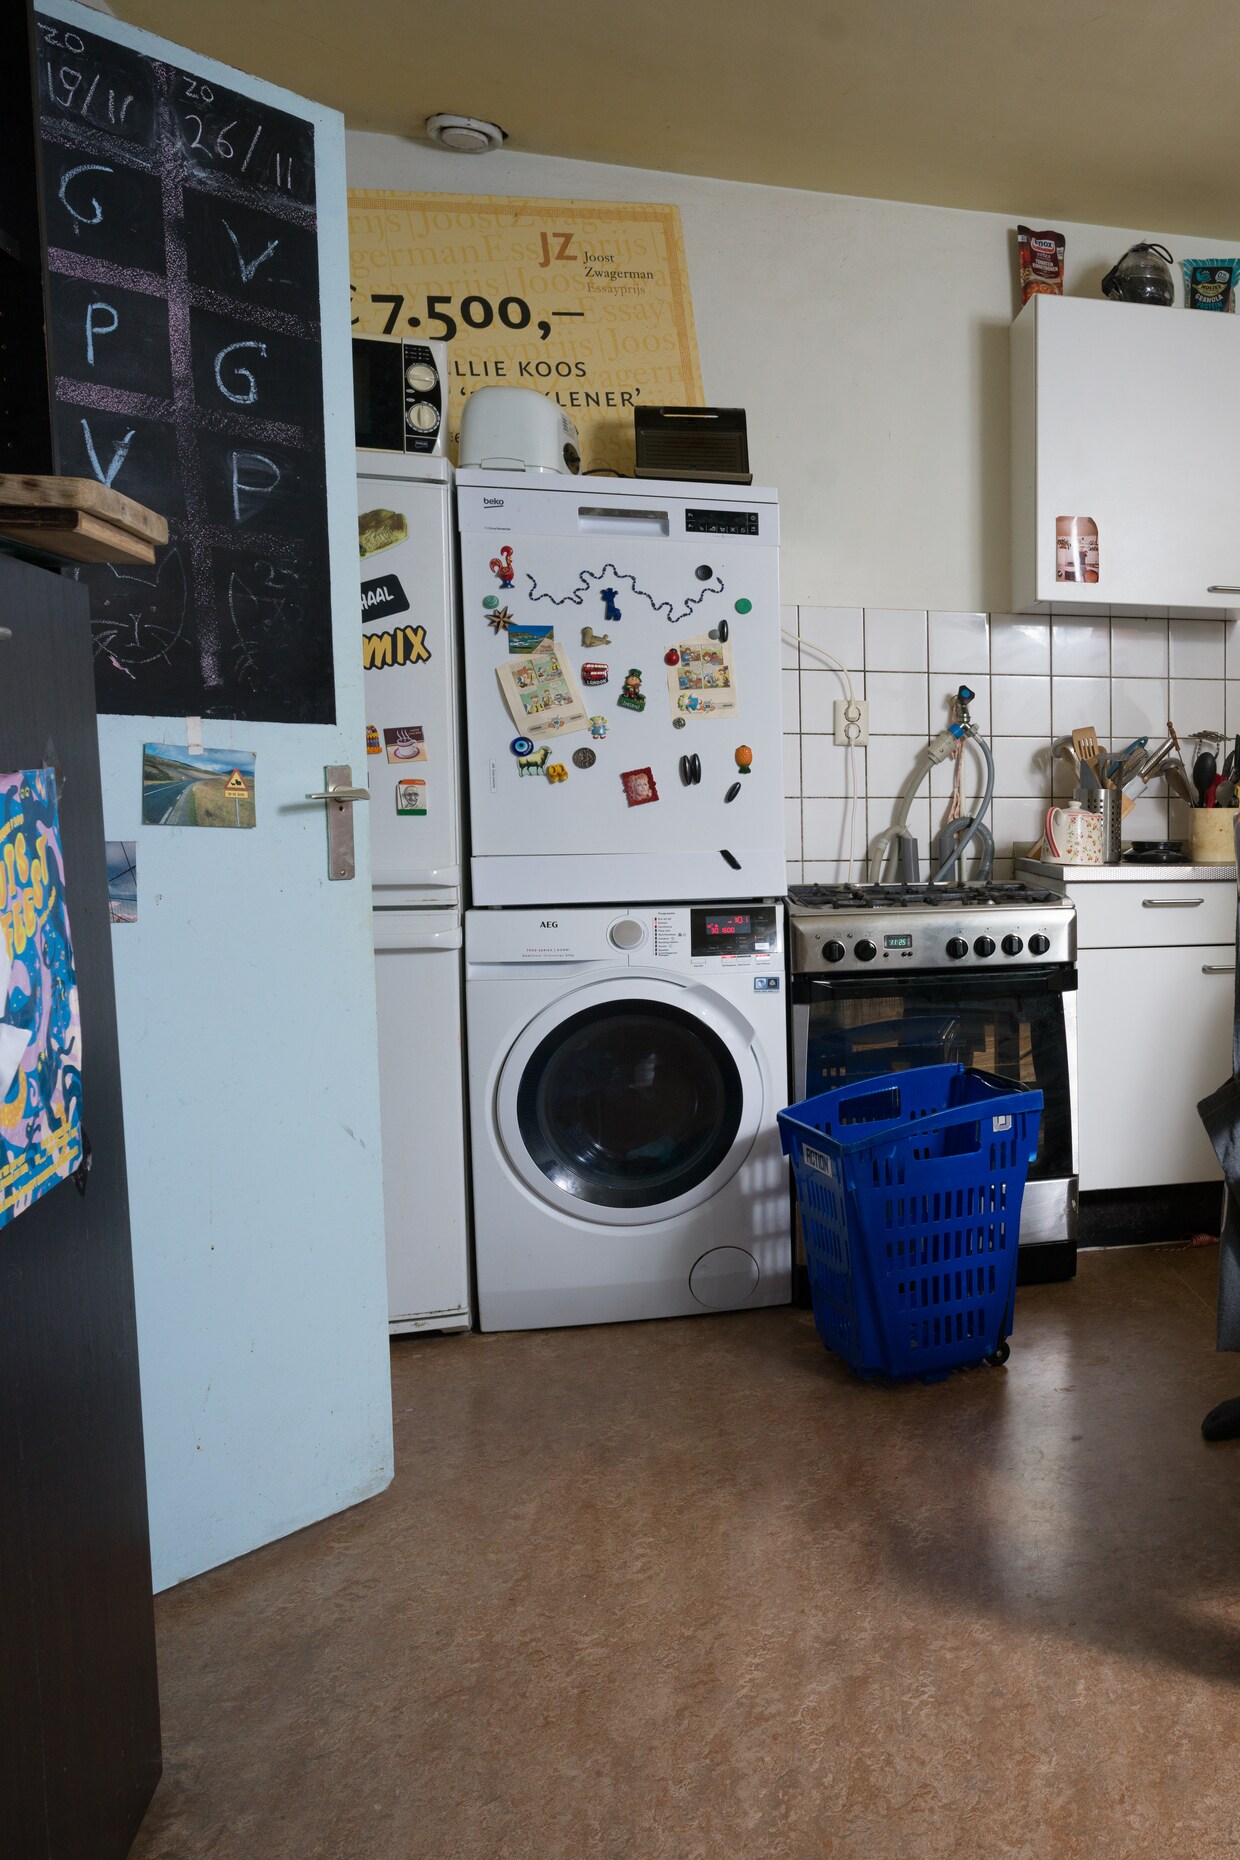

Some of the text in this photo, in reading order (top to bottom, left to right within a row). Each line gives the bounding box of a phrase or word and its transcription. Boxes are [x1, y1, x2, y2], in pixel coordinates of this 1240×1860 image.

[538, 232, 578, 268] JZ
[583, 251, 615, 264] Joost
[584, 266, 654, 280] Zwagerman
[587, 282, 646, 296] Essayprijs
[1195, 293, 1224, 303] GRANOLA
[448, 360, 587, 377] LLIE KOOS
[483, 497, 505, 506] beko
[539, 921, 559, 929] AEG
[806, 1146, 831, 1176] ACTION
